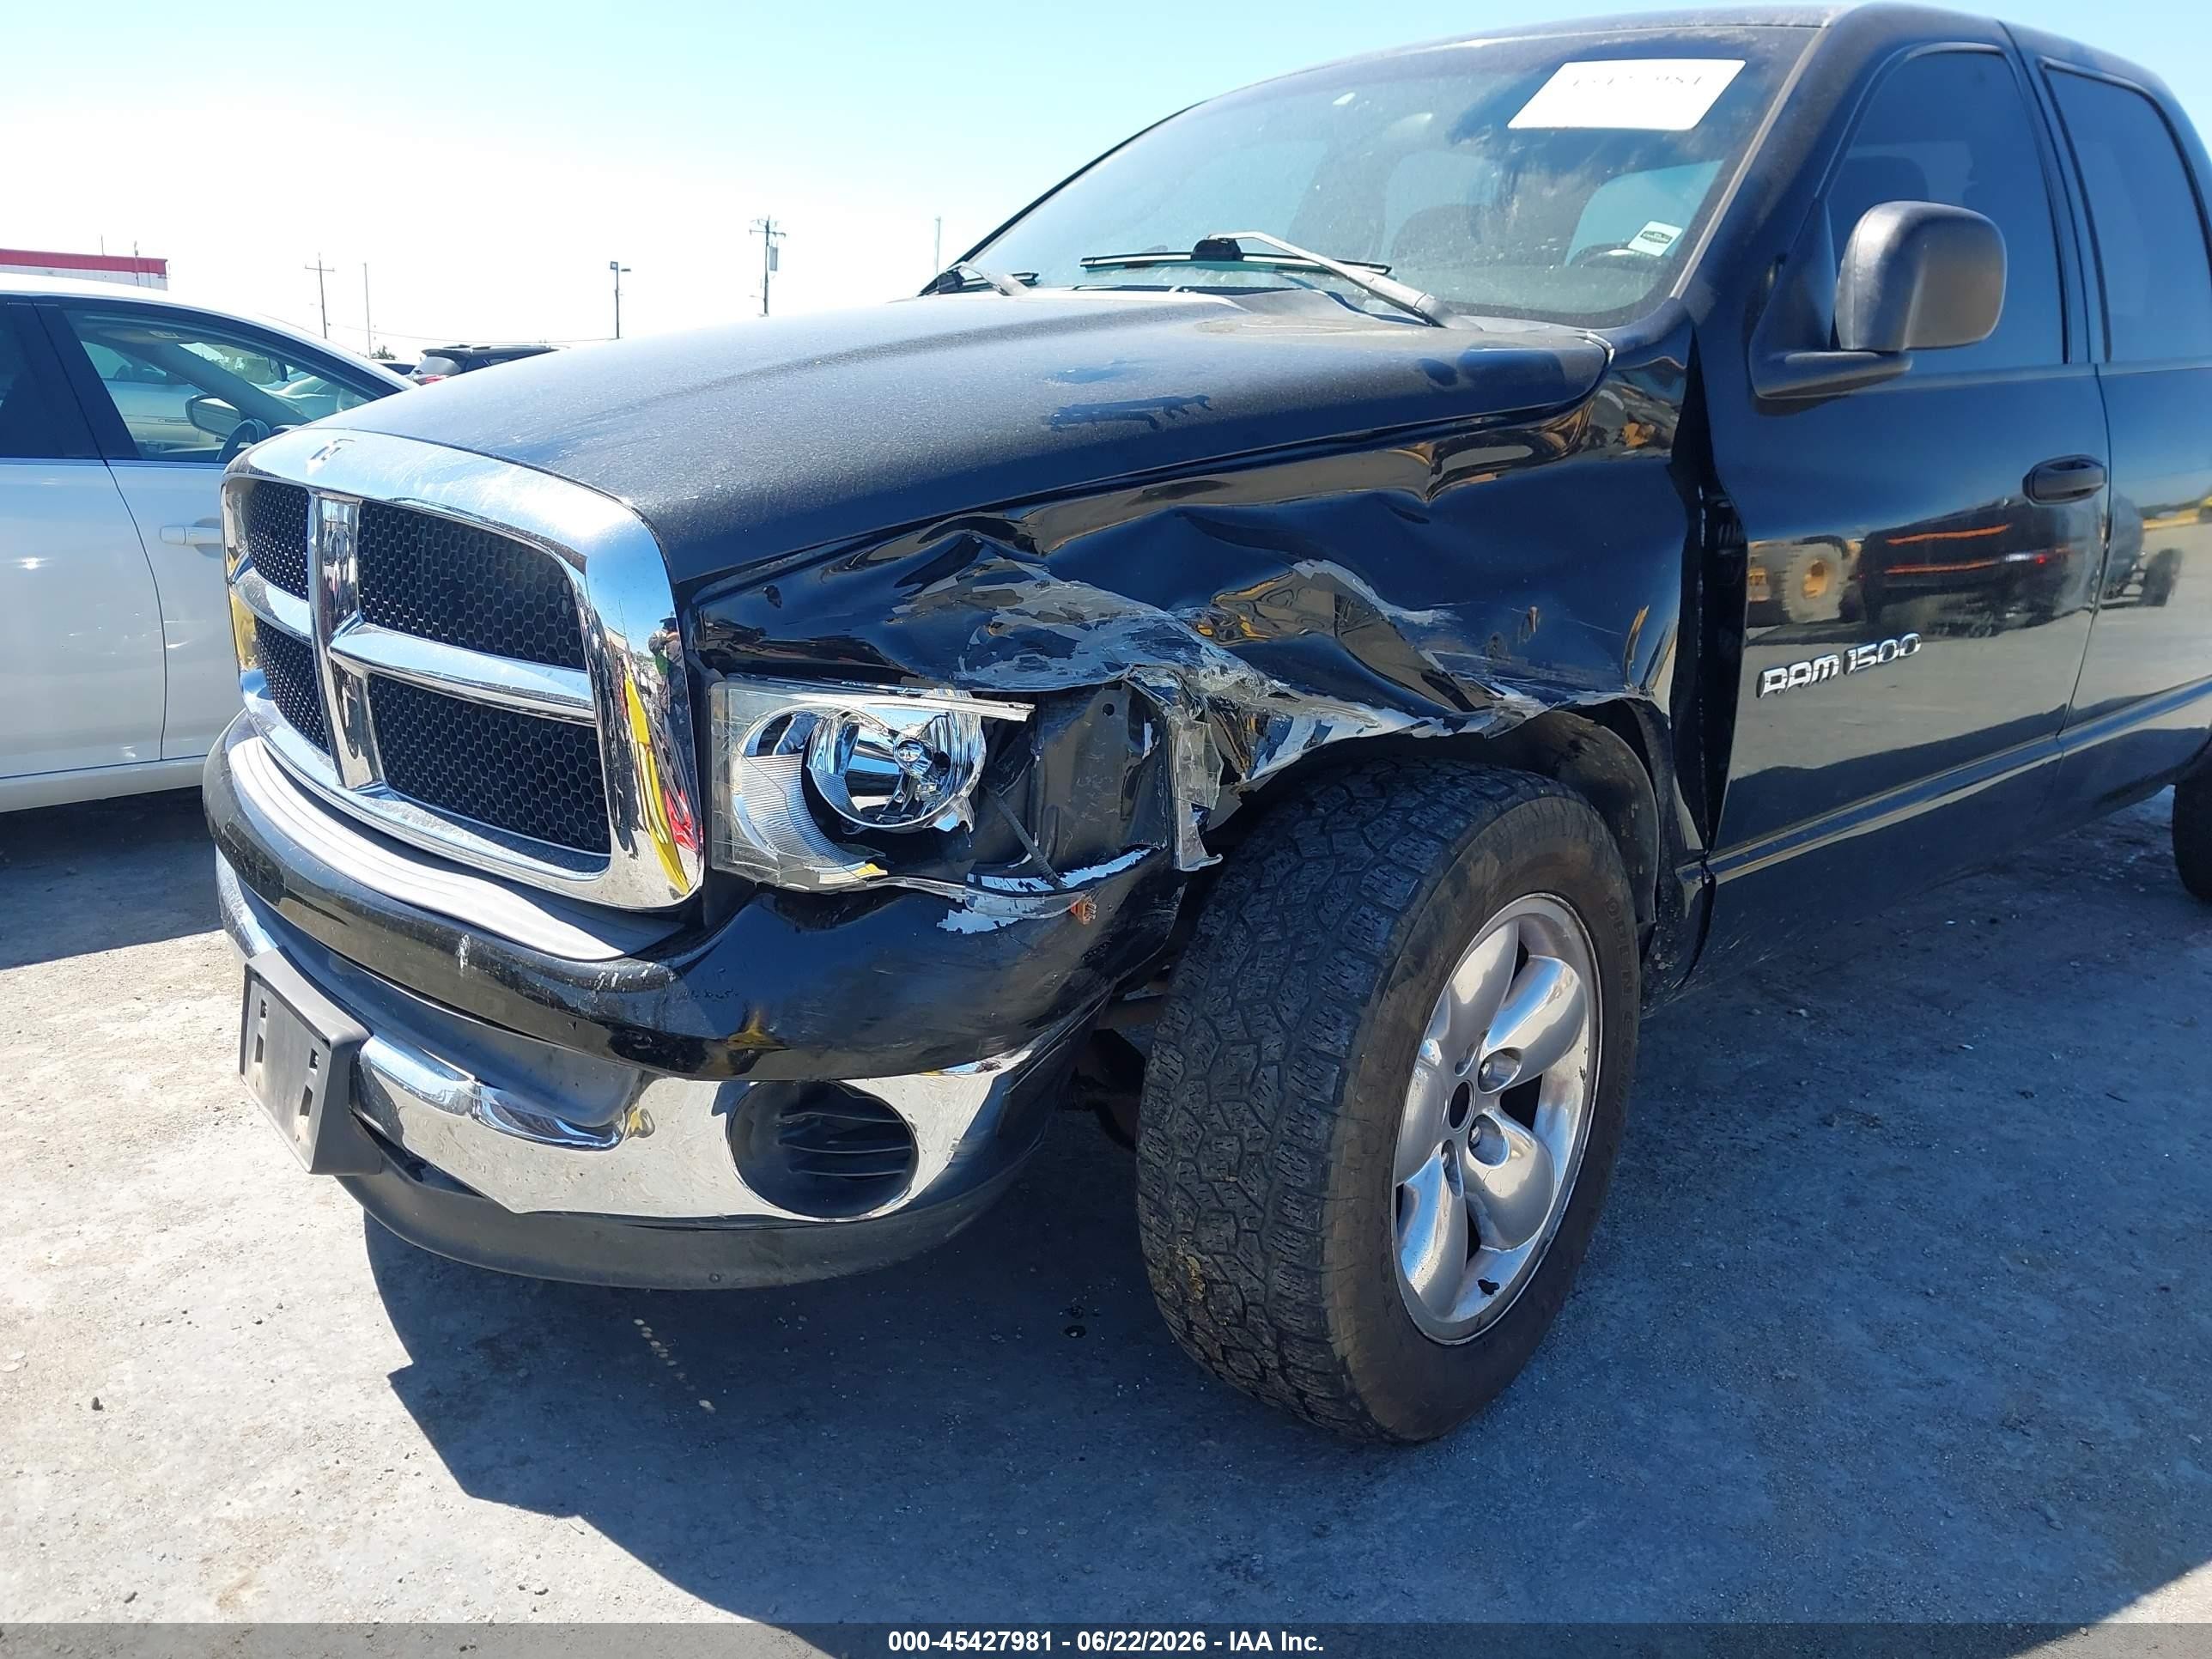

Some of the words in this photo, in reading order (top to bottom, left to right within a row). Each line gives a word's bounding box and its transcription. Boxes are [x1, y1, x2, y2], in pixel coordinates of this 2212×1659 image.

[1757, 654, 1840, 697] RAM
[1844, 633, 1922, 674] 1500
[1606, 896, 1633, 996] OPEN
